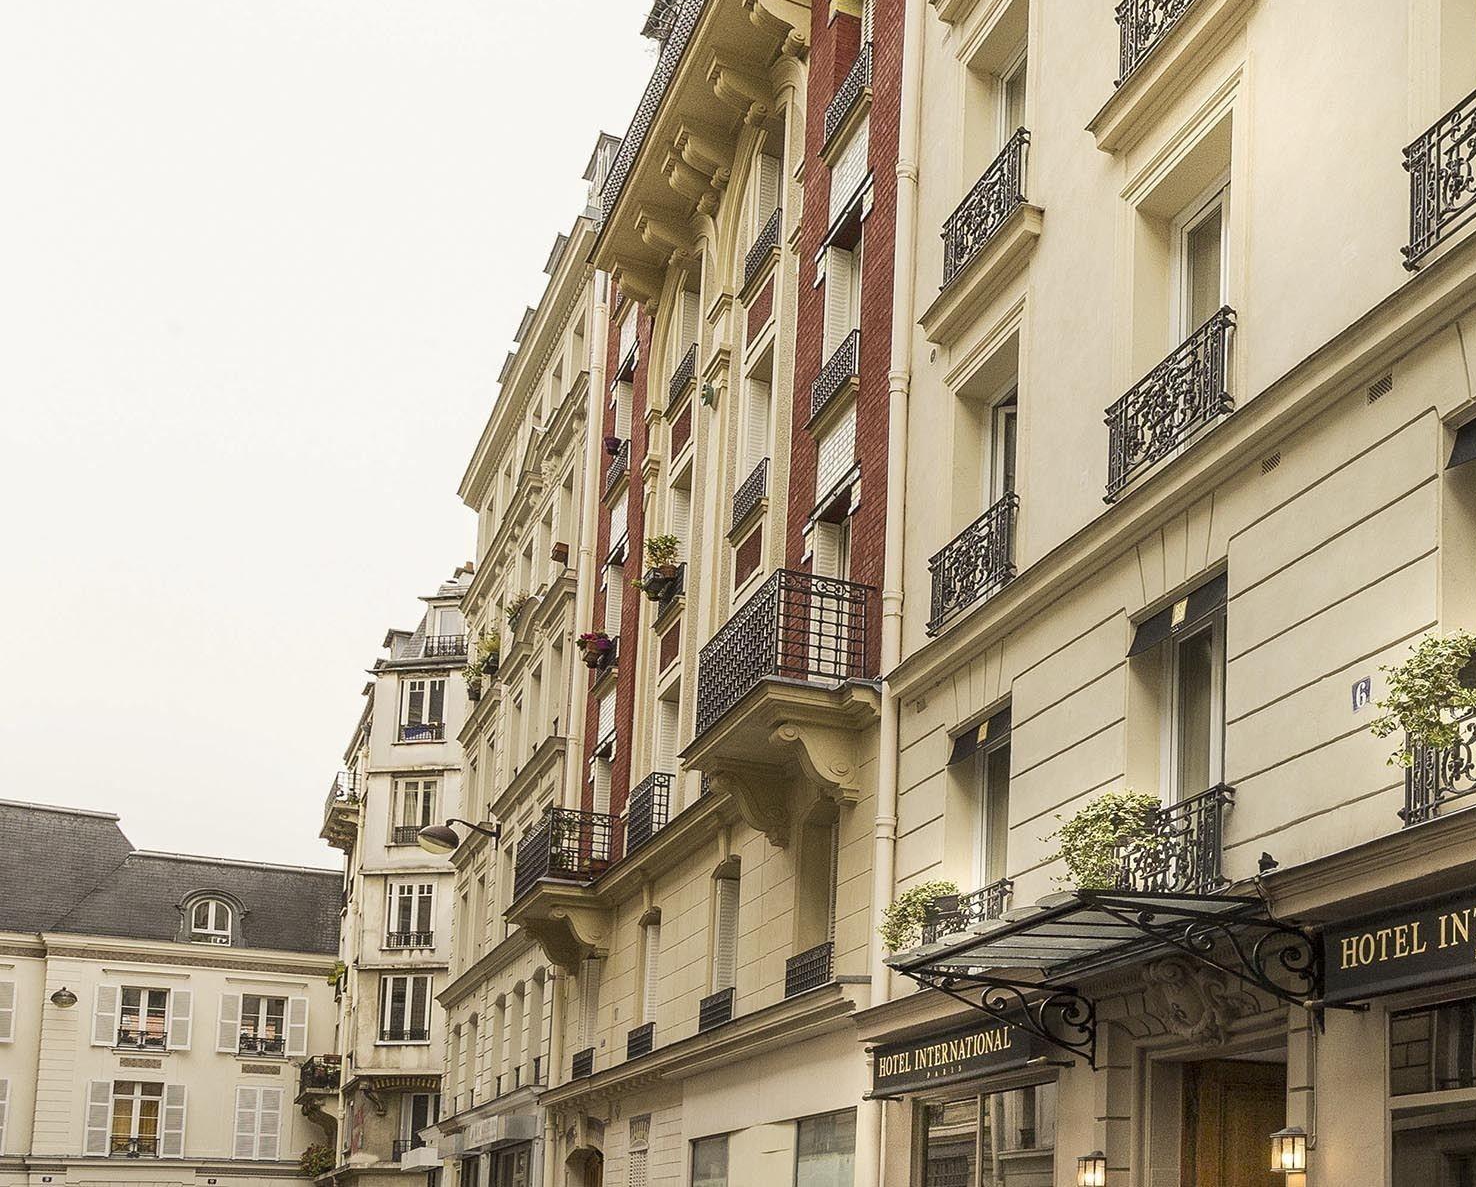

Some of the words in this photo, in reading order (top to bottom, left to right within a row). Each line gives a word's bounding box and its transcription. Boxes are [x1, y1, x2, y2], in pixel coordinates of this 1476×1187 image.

[1356, 681, 1367, 708] 6
[1340, 921, 1427, 970] HOTEL
[878, 1052, 912, 1078] HOTEL
[914, 1026, 1012, 1071] INTERNATIONAL
